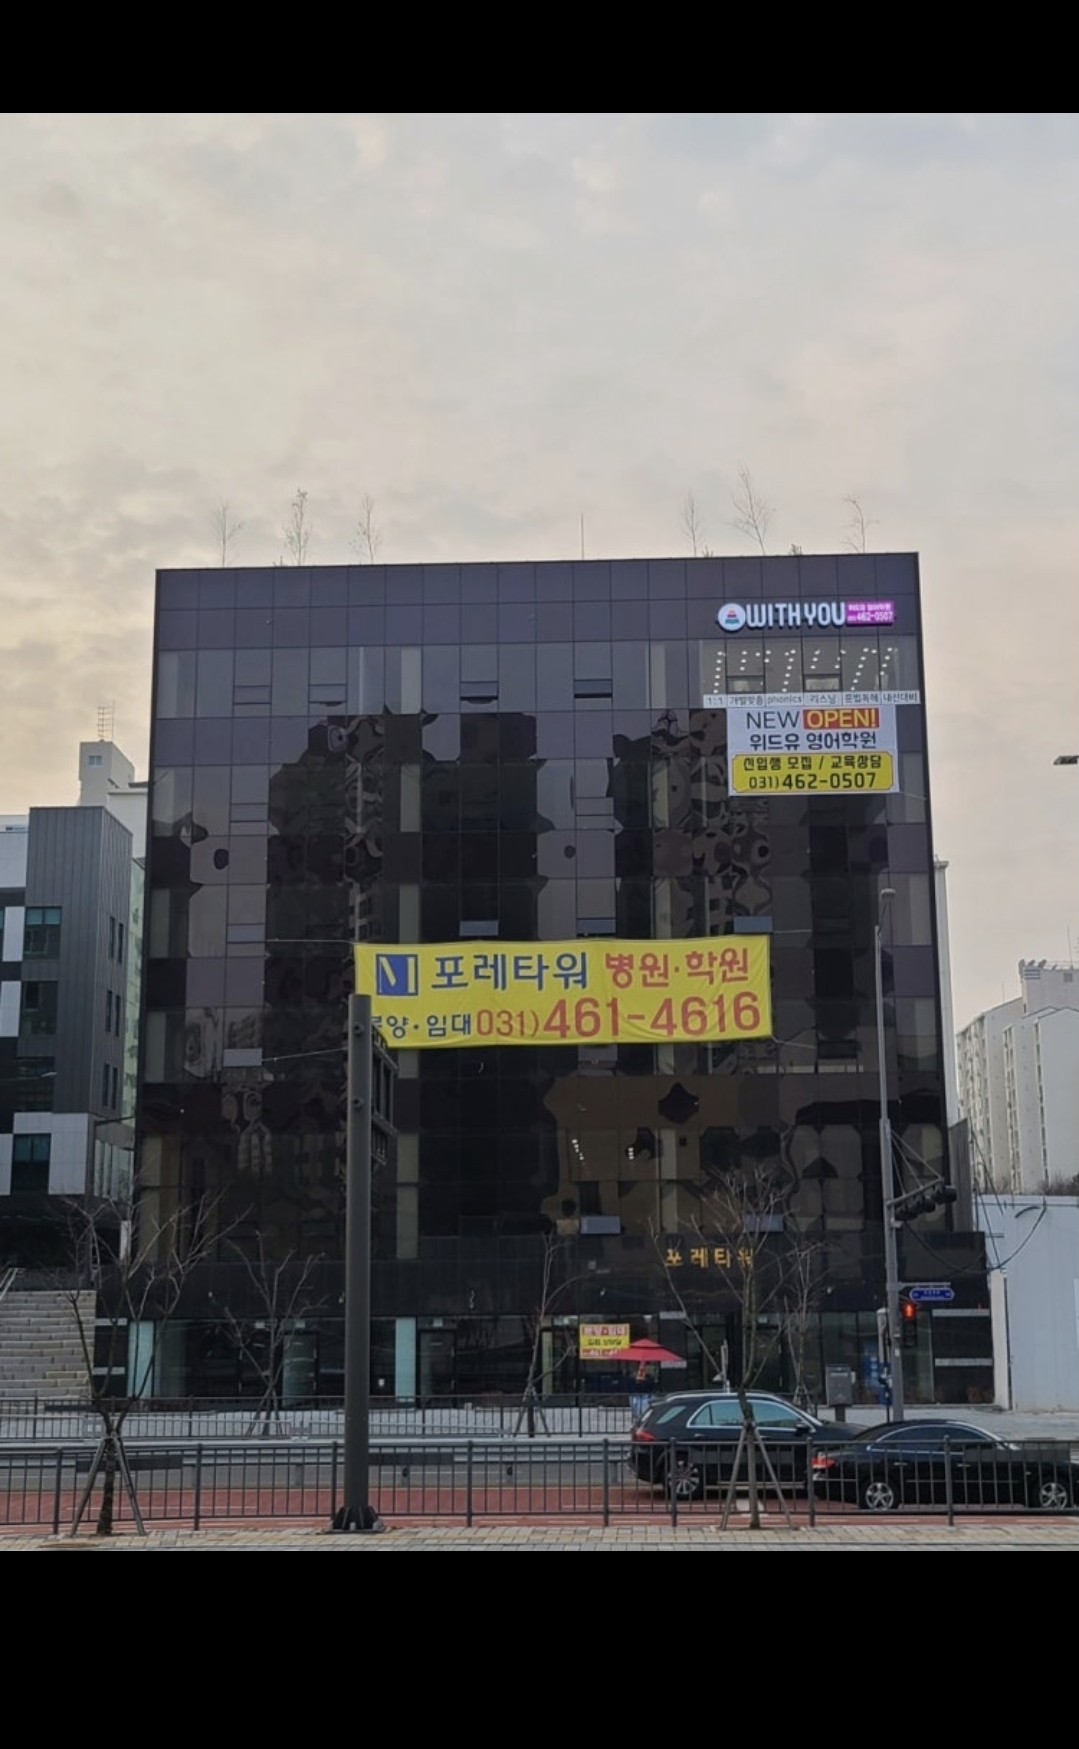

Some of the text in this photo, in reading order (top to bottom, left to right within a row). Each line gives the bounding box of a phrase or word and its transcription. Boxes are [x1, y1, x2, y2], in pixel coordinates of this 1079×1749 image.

[746, 601, 846, 627] WITH YOU
[768, 693, 802, 705] phonics
[746, 709, 877, 730] NEW OPEN!
[750, 731, 877, 751] 위드유 영어학원
[743, 756, 782, 771] 신입생
[787, 755, 812, 770] 모집
[830, 754, 882, 769] 교육상담
[431, 952, 587, 991] 포레타워
